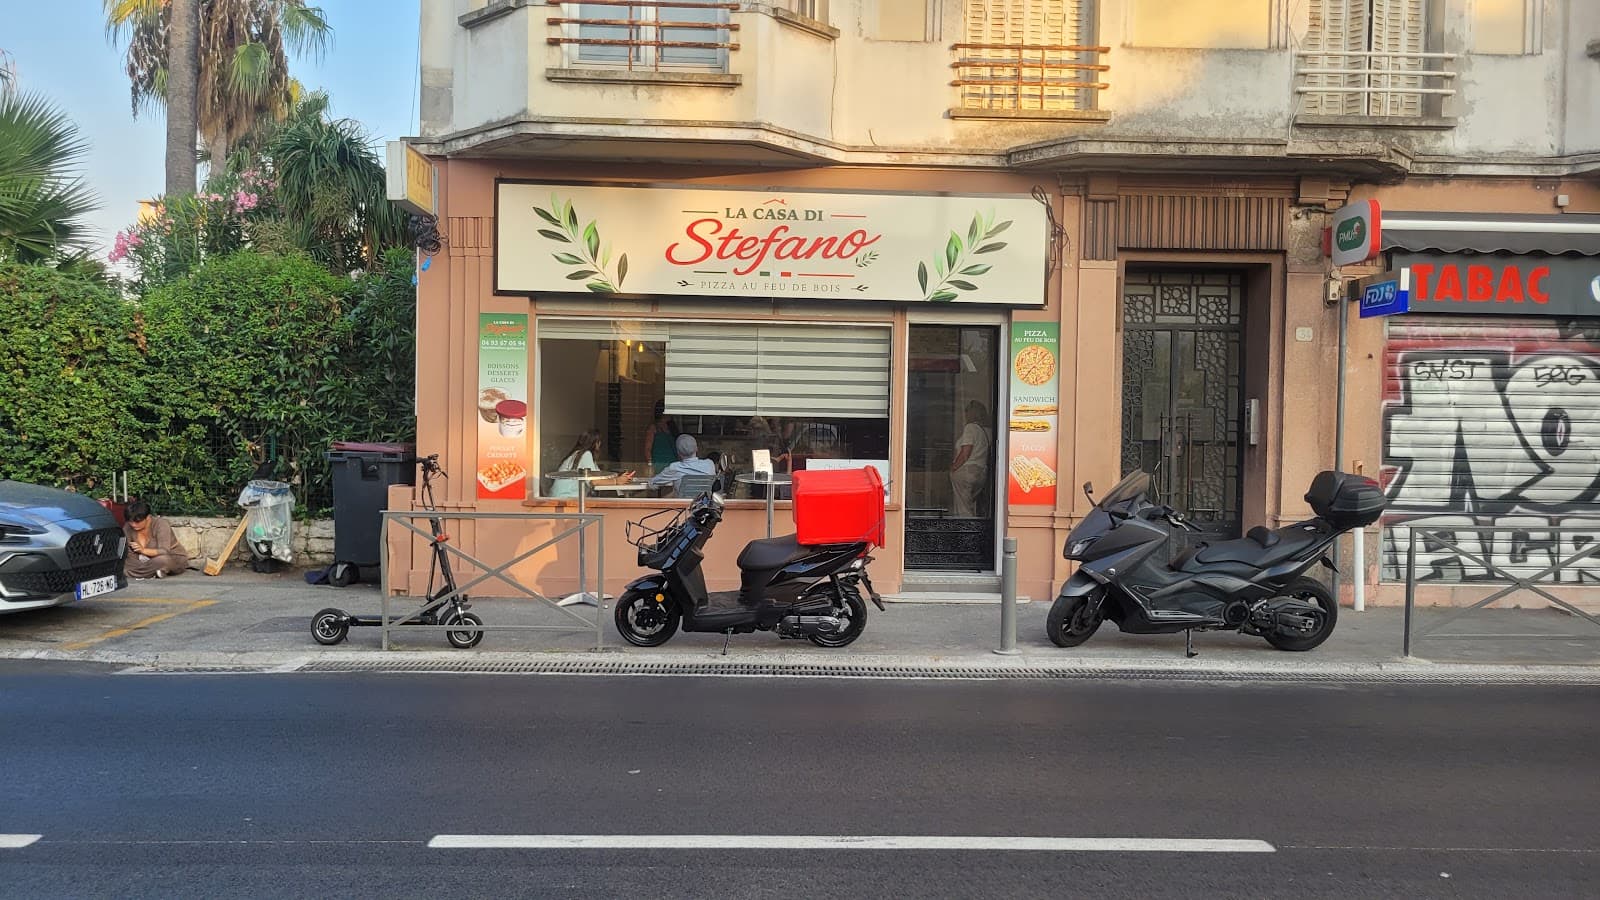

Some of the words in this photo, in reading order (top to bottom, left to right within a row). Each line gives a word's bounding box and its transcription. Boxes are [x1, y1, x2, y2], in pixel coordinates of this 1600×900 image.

[725, 207, 747, 219] LA
[753, 208, 799, 221] CASA
[804, 209, 824, 222] DI
[1339, 231, 1354, 244] PMU
[665, 218, 881, 276] Stefano
[700, 281, 736, 290] PIZZA
[742, 282, 758, 291] AU
[763, 282, 786, 291] FEU
[792, 283, 807, 292] DE
[813, 283, 841, 293] BOIS
[1411, 263, 1550, 304] TABAC
[1365, 286, 1384, 305] FDJ
